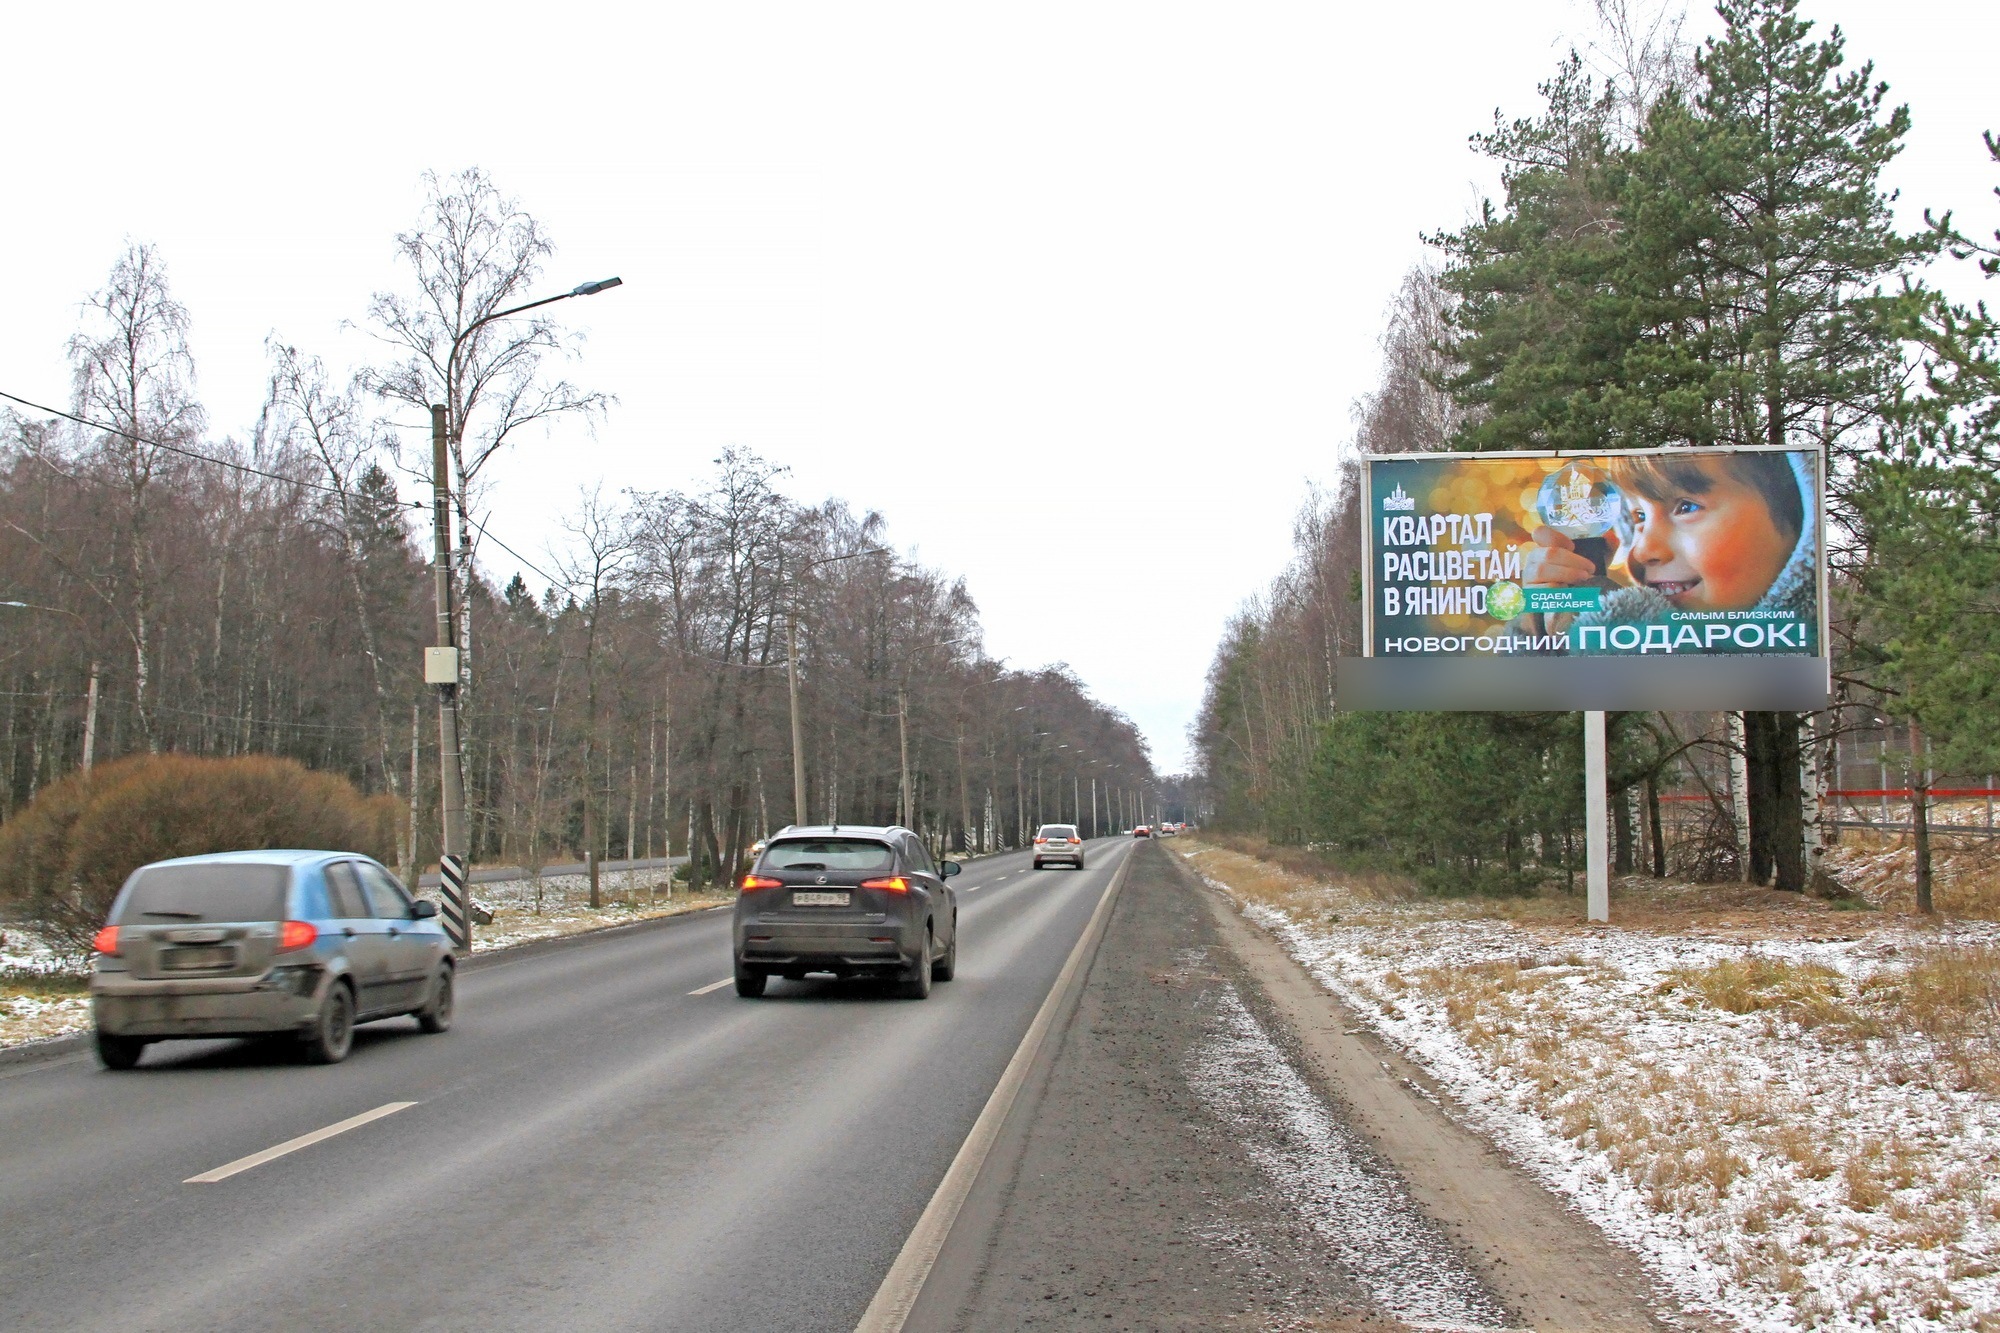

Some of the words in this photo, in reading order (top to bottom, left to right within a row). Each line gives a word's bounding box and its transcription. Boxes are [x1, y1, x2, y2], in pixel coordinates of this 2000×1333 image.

[1384, 512, 1492, 545] КВАРТАЛ
[1384, 544, 1520, 584] РАСЦВЕТАЙ
[1384, 587, 1400, 615] В
[1405, 585, 1488, 615] ЯНИНО
[1531, 592, 1572, 601] СДАЕМ
[1531, 601, 1539, 609] В
[1541, 600, 1594, 609] ДЕКАБРЕ
[1671, 611, 1725, 621] САМЫМ
[1728, 610, 1795, 620] БЛИЗКИМ
[1384, 632, 1570, 654] НОВОГОДНИЙ
[1579, 623, 1807, 654] ПОДАРОК!
